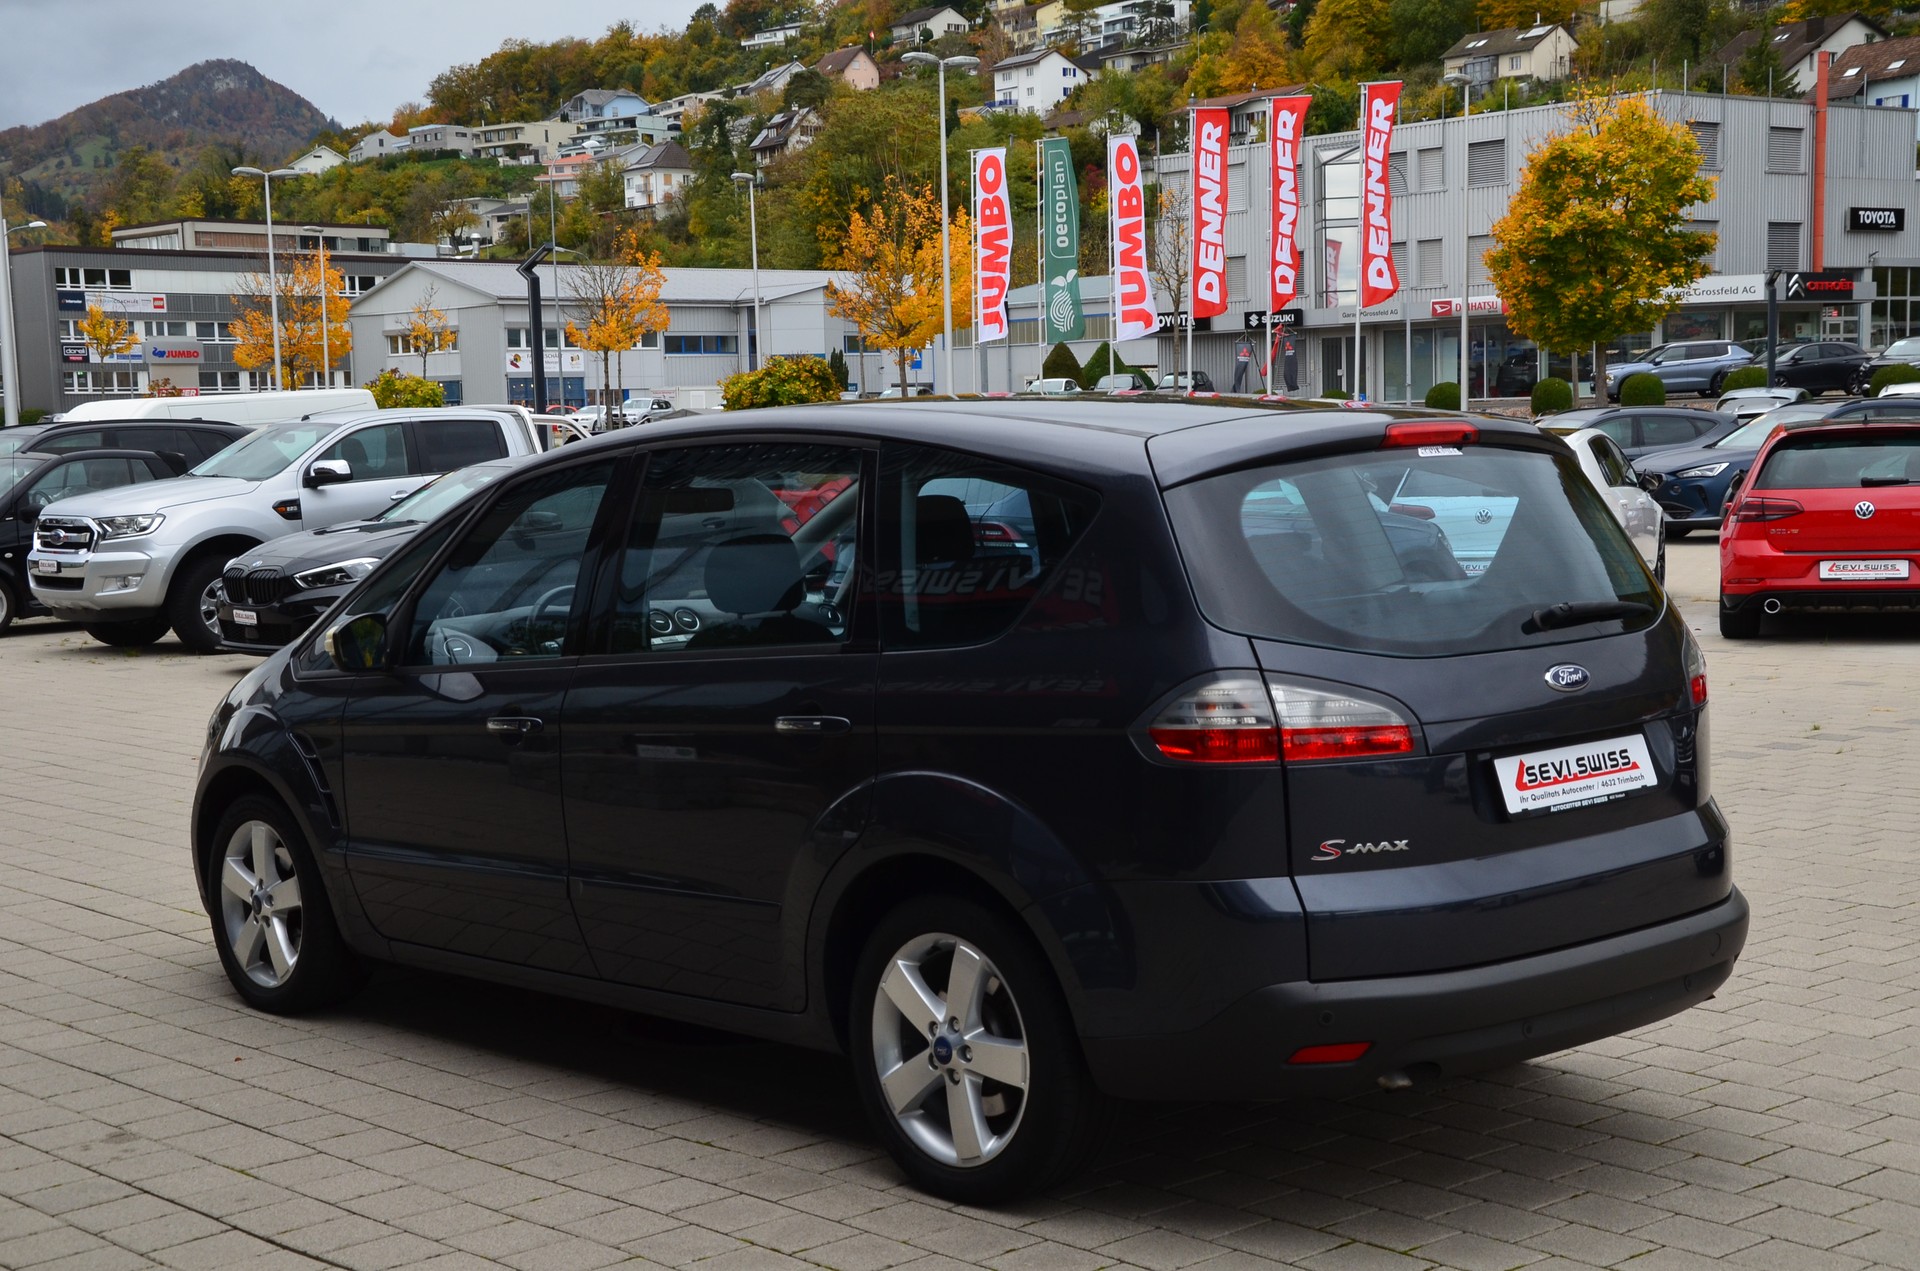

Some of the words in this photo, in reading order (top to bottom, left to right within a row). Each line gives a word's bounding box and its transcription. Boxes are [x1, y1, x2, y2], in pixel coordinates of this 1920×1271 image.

[1053, 161, 1069, 248] oecoplan
[1274, 109, 1298, 295] DENNER
[1367, 98, 1394, 290] DENNER
[1198, 121, 1224, 304] DENNER
[1858, 210, 1896, 224] TOYOTA
[979, 155, 1009, 334] JUMBO
[1115, 143, 1154, 330] JUMBO
[1455, 301, 1498, 312] DIHATSU
[1694, 285, 1739, 297] Grossfeld
[1742, 286, 1756, 294] AG
[1389, 308, 1398, 316] AG
[166, 350, 200, 359] JUMBO
[1834, 563, 1861, 571] SEVI
[1863, 563, 1898, 571] SWISS
[1559, 667, 1583, 685] Ford
[1525, 759, 1572, 784] SEVI
[1575, 748, 1632, 774] SWISS
[1519, 795, 1529, 804] Ihr
[1561, 784, 1595, 796] Autocenter
[1601, 779, 1616, 788] 4632
[1617, 773, 1645, 785] Trimbach
